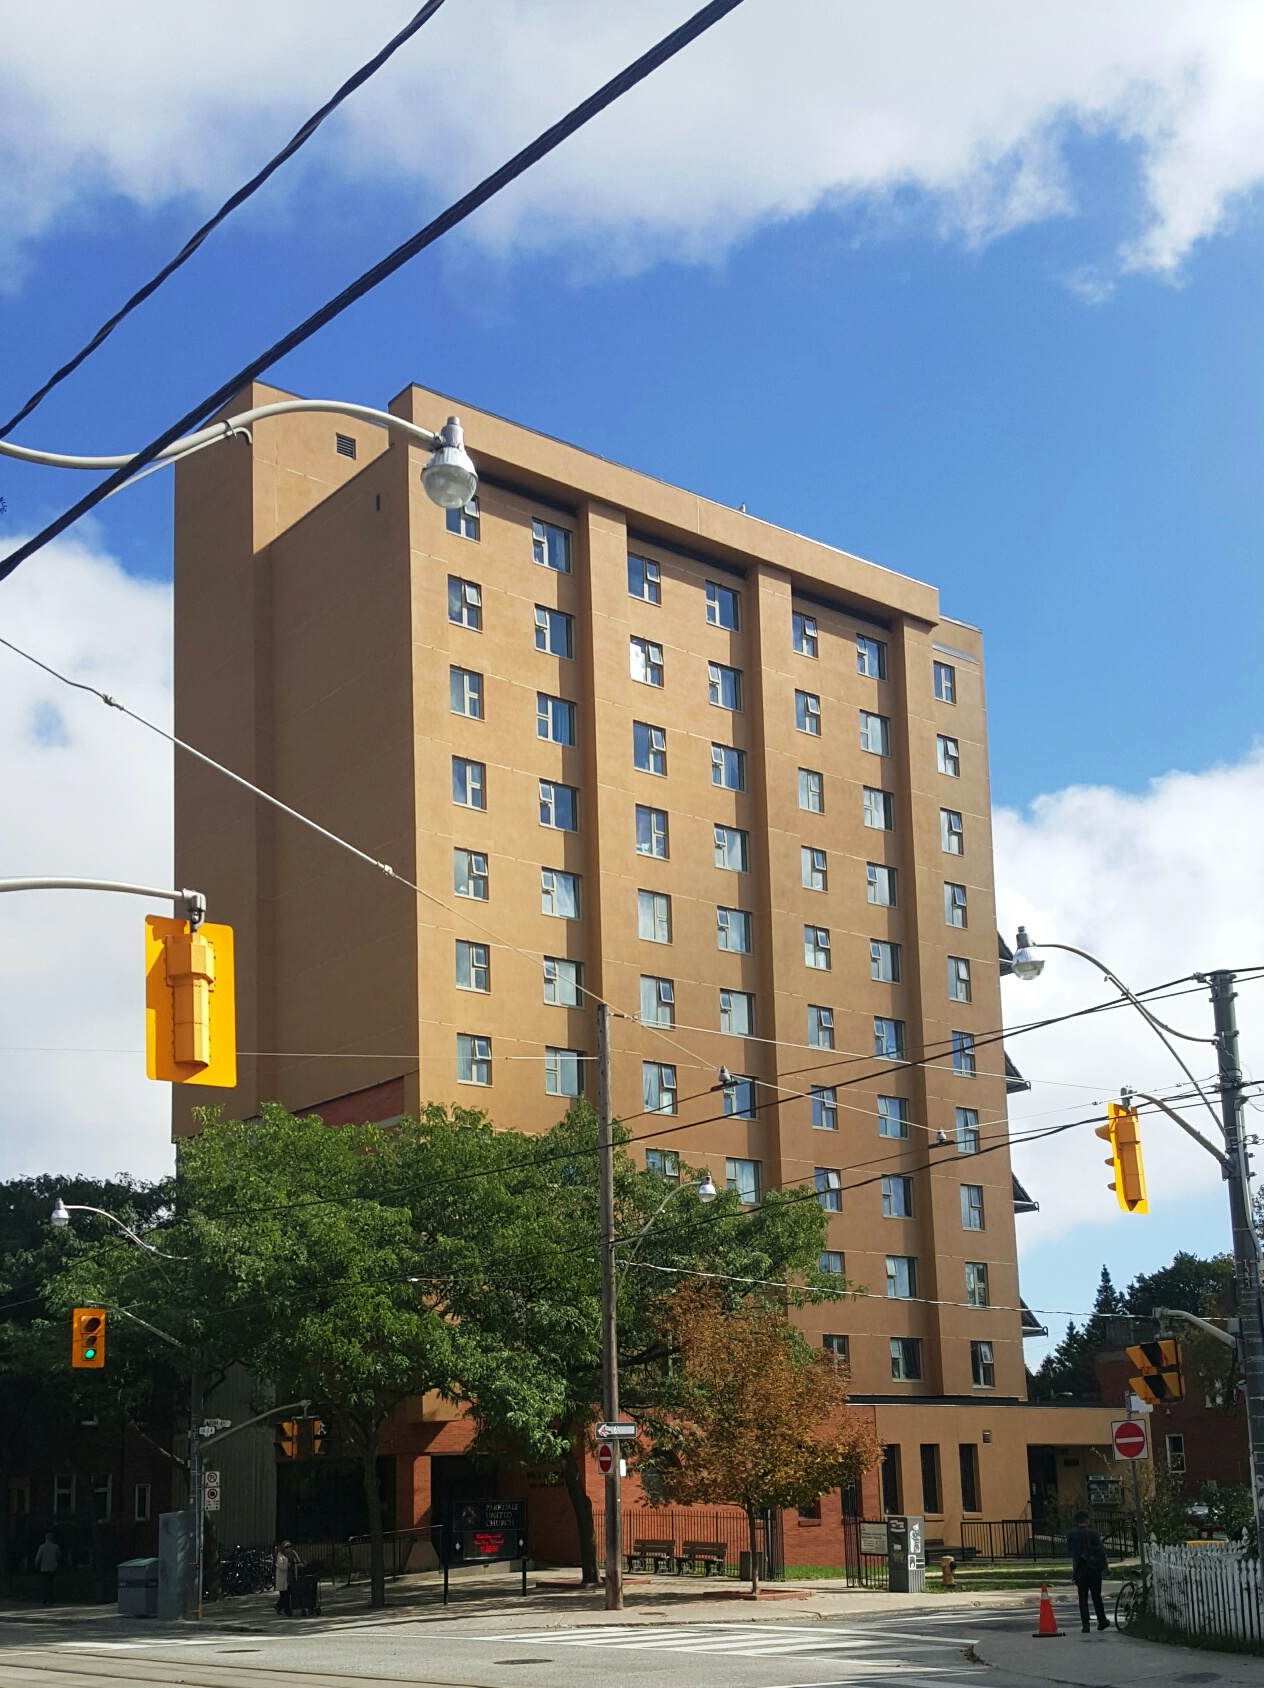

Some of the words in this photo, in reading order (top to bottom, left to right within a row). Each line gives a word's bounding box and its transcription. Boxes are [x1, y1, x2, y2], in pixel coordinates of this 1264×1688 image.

[485, 1503, 519, 1511] PARKDALE
[485, 1511, 513, 1519] UNITED
[485, 1519, 515, 1527] CHURCH
